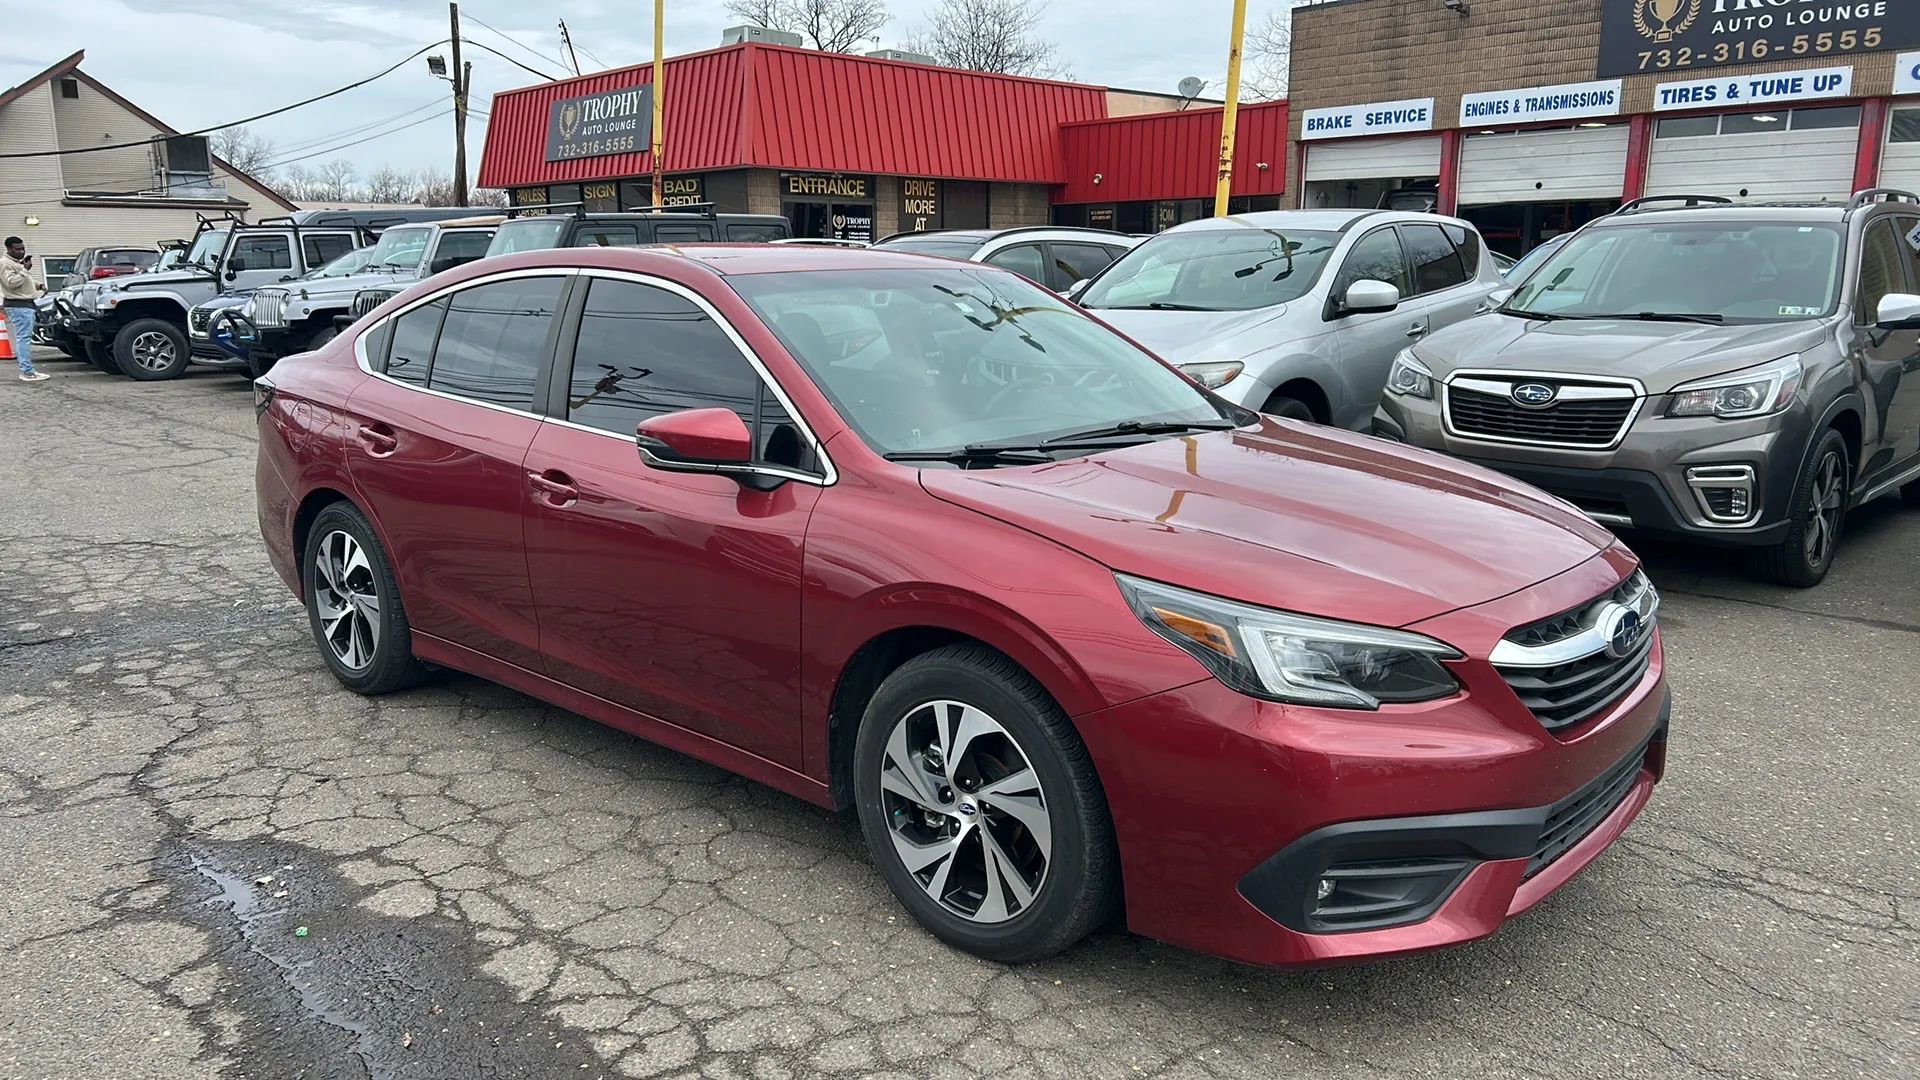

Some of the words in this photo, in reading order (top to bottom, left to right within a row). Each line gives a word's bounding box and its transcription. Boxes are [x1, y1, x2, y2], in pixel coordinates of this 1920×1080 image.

[1711, 14, 1774, 34] AUTO
[1786, 4, 1887, 26] LOUNGE
[1637, 27, 1883, 70] 732-316-5555
[1661, 84, 1717, 105] TIRES
[1726, 84, 1740, 99] &
[1750, 77, 1803, 97] TUNE
[1813, 74, 1843, 91] UP
[582, 90, 643, 122] TROPHY
[1465, 98, 1510, 117] ENGINES
[1513, 99, 1521, 113] &
[1525, 89, 1615, 113] TRANSMISSIONS
[582, 124, 602, 136] AUTO
[605, 119, 637, 133] LOUNGE
[1307, 115, 1353, 131] BRAKE
[1365, 108, 1427, 126] SERVICE
[558, 136, 634, 158] 732-316-5555
[516, 188, 547, 203] PAYLESS
[584, 184, 616, 199] SIGN
[663, 179, 697, 194] BAD
[789, 176, 865, 197] ENTRANCE
[904, 180, 936, 197] DRIVE
[905, 199, 936, 215] MORE
[914, 217, 927, 231] AT
